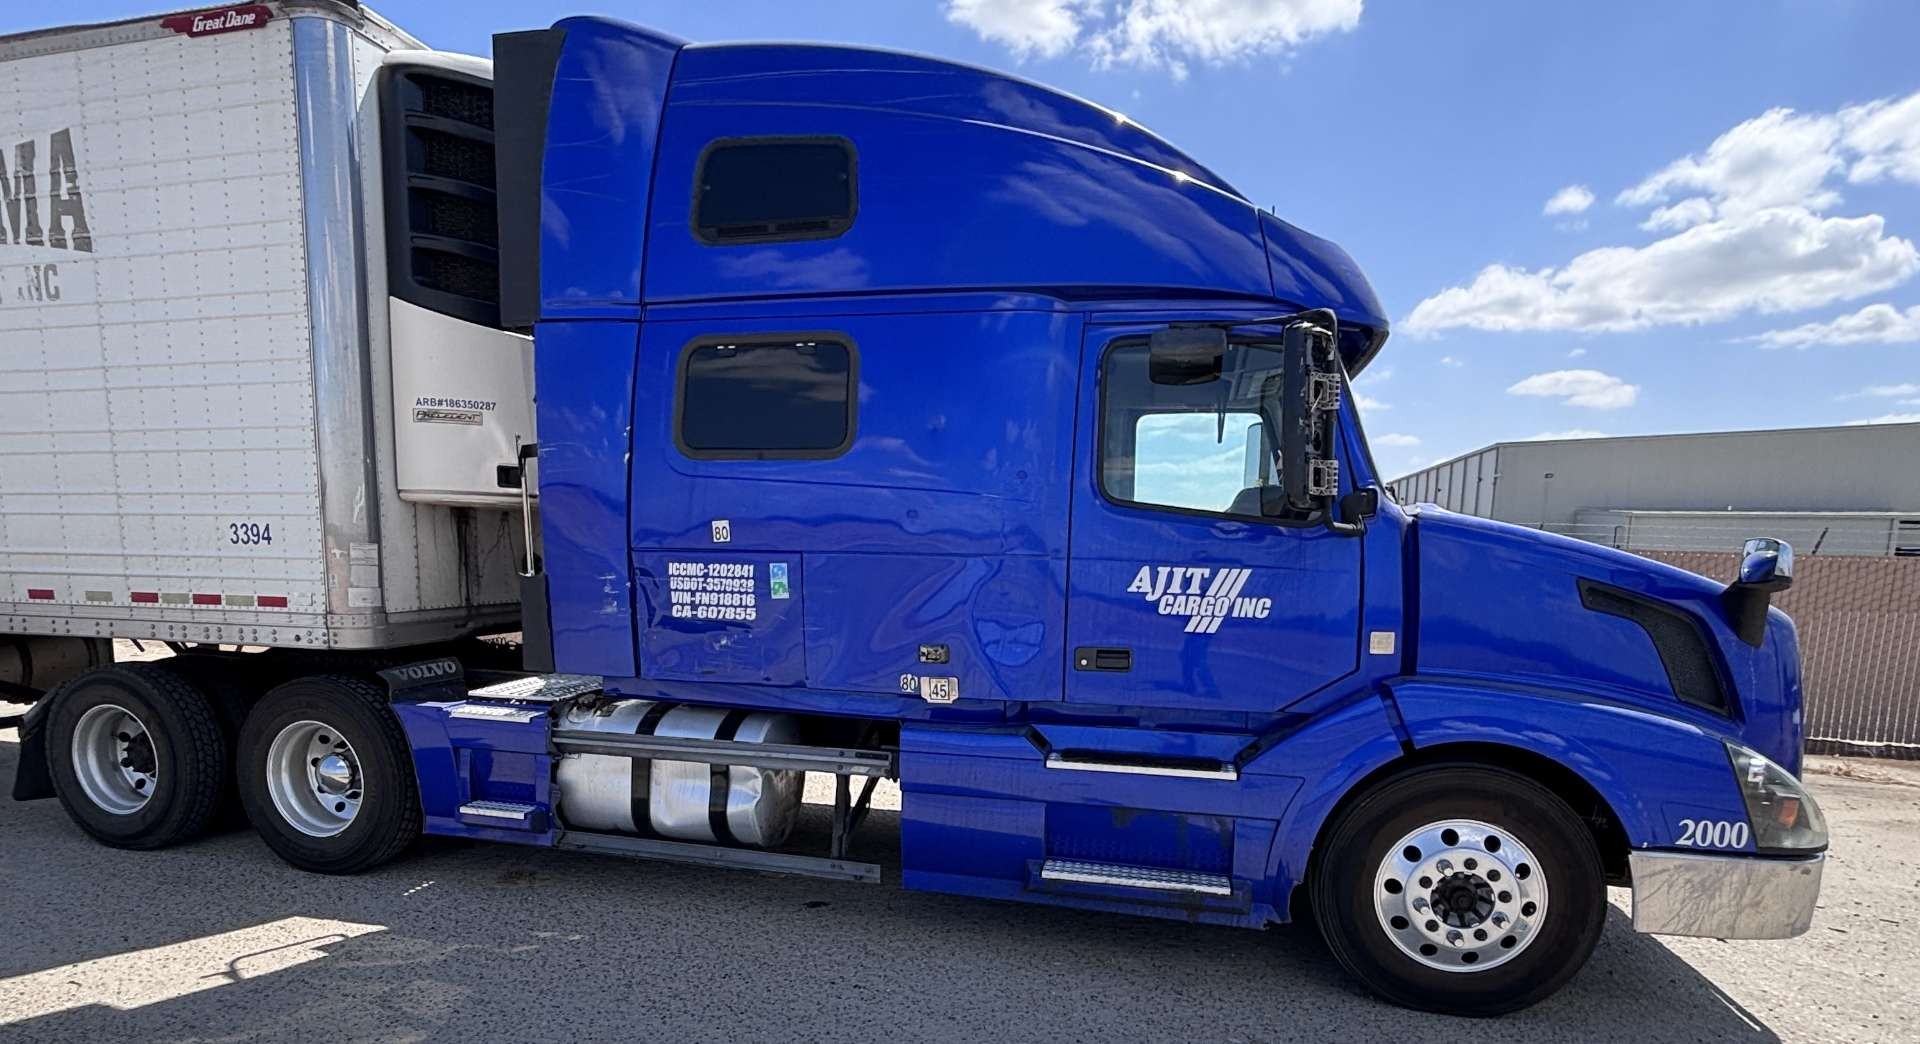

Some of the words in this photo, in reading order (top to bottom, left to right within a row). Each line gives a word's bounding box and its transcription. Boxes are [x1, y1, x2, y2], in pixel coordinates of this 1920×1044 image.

[192, 15, 225, 32] Great
[225, 10, 256, 28] Dane
[415, 397, 497, 411] ARB#186350287
[230, 523, 272, 545] 3394
[714, 526, 729, 541] 80
[668, 562, 755, 578] ICCMC-1202841
[1127, 565, 1210, 602] AJIT
[1157, 594, 1232, 618] CARGO
[1231, 597, 1272, 619] INC
[391, 661, 457, 681] VOLVO
[901, 676, 917, 691] 80
[931, 683, 948, 698] 45
[1675, 819, 1749, 849] 2000
